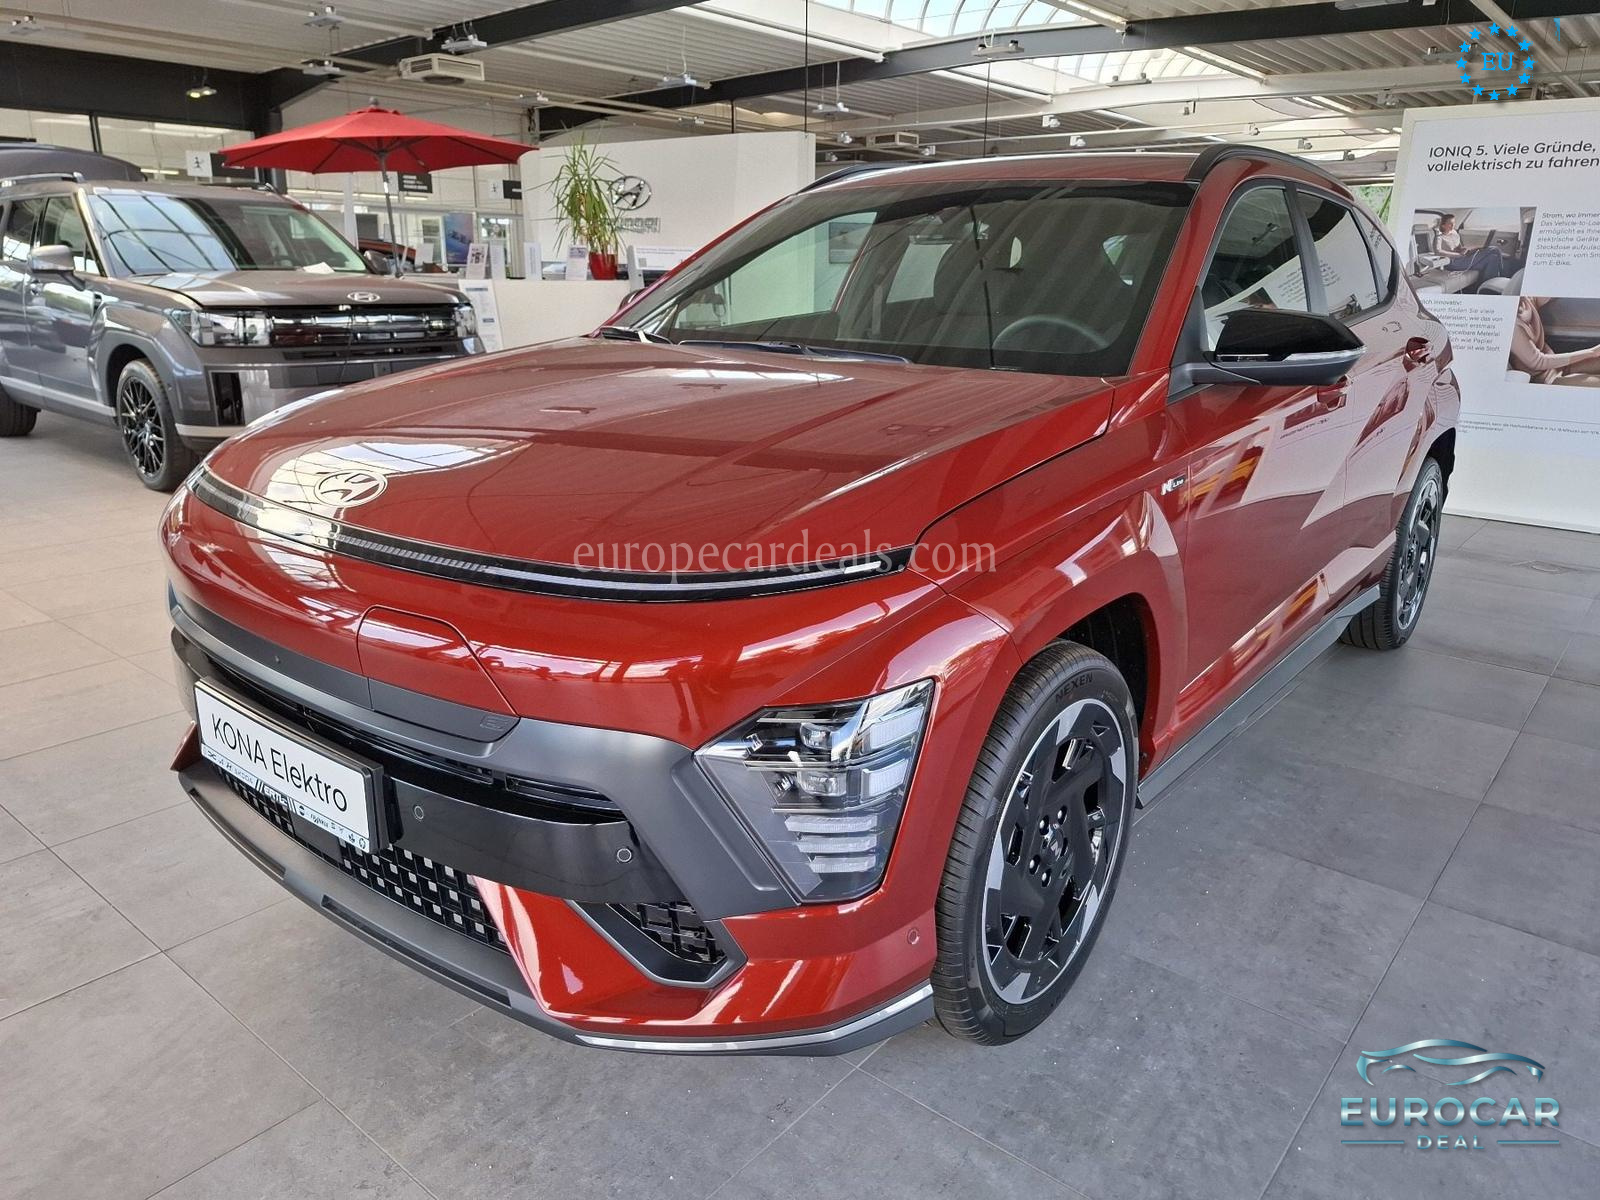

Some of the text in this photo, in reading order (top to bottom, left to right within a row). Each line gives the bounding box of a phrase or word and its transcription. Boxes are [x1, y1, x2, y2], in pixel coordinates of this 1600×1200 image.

[1429, 140, 1596, 158] IONIQ 5. Viele Gründe,
[1427, 156, 1600, 172] vollelektrisch zu fahren
[1055, 672, 1093, 703] NEXEN
[212, 713, 347, 812] KONA Elektro
